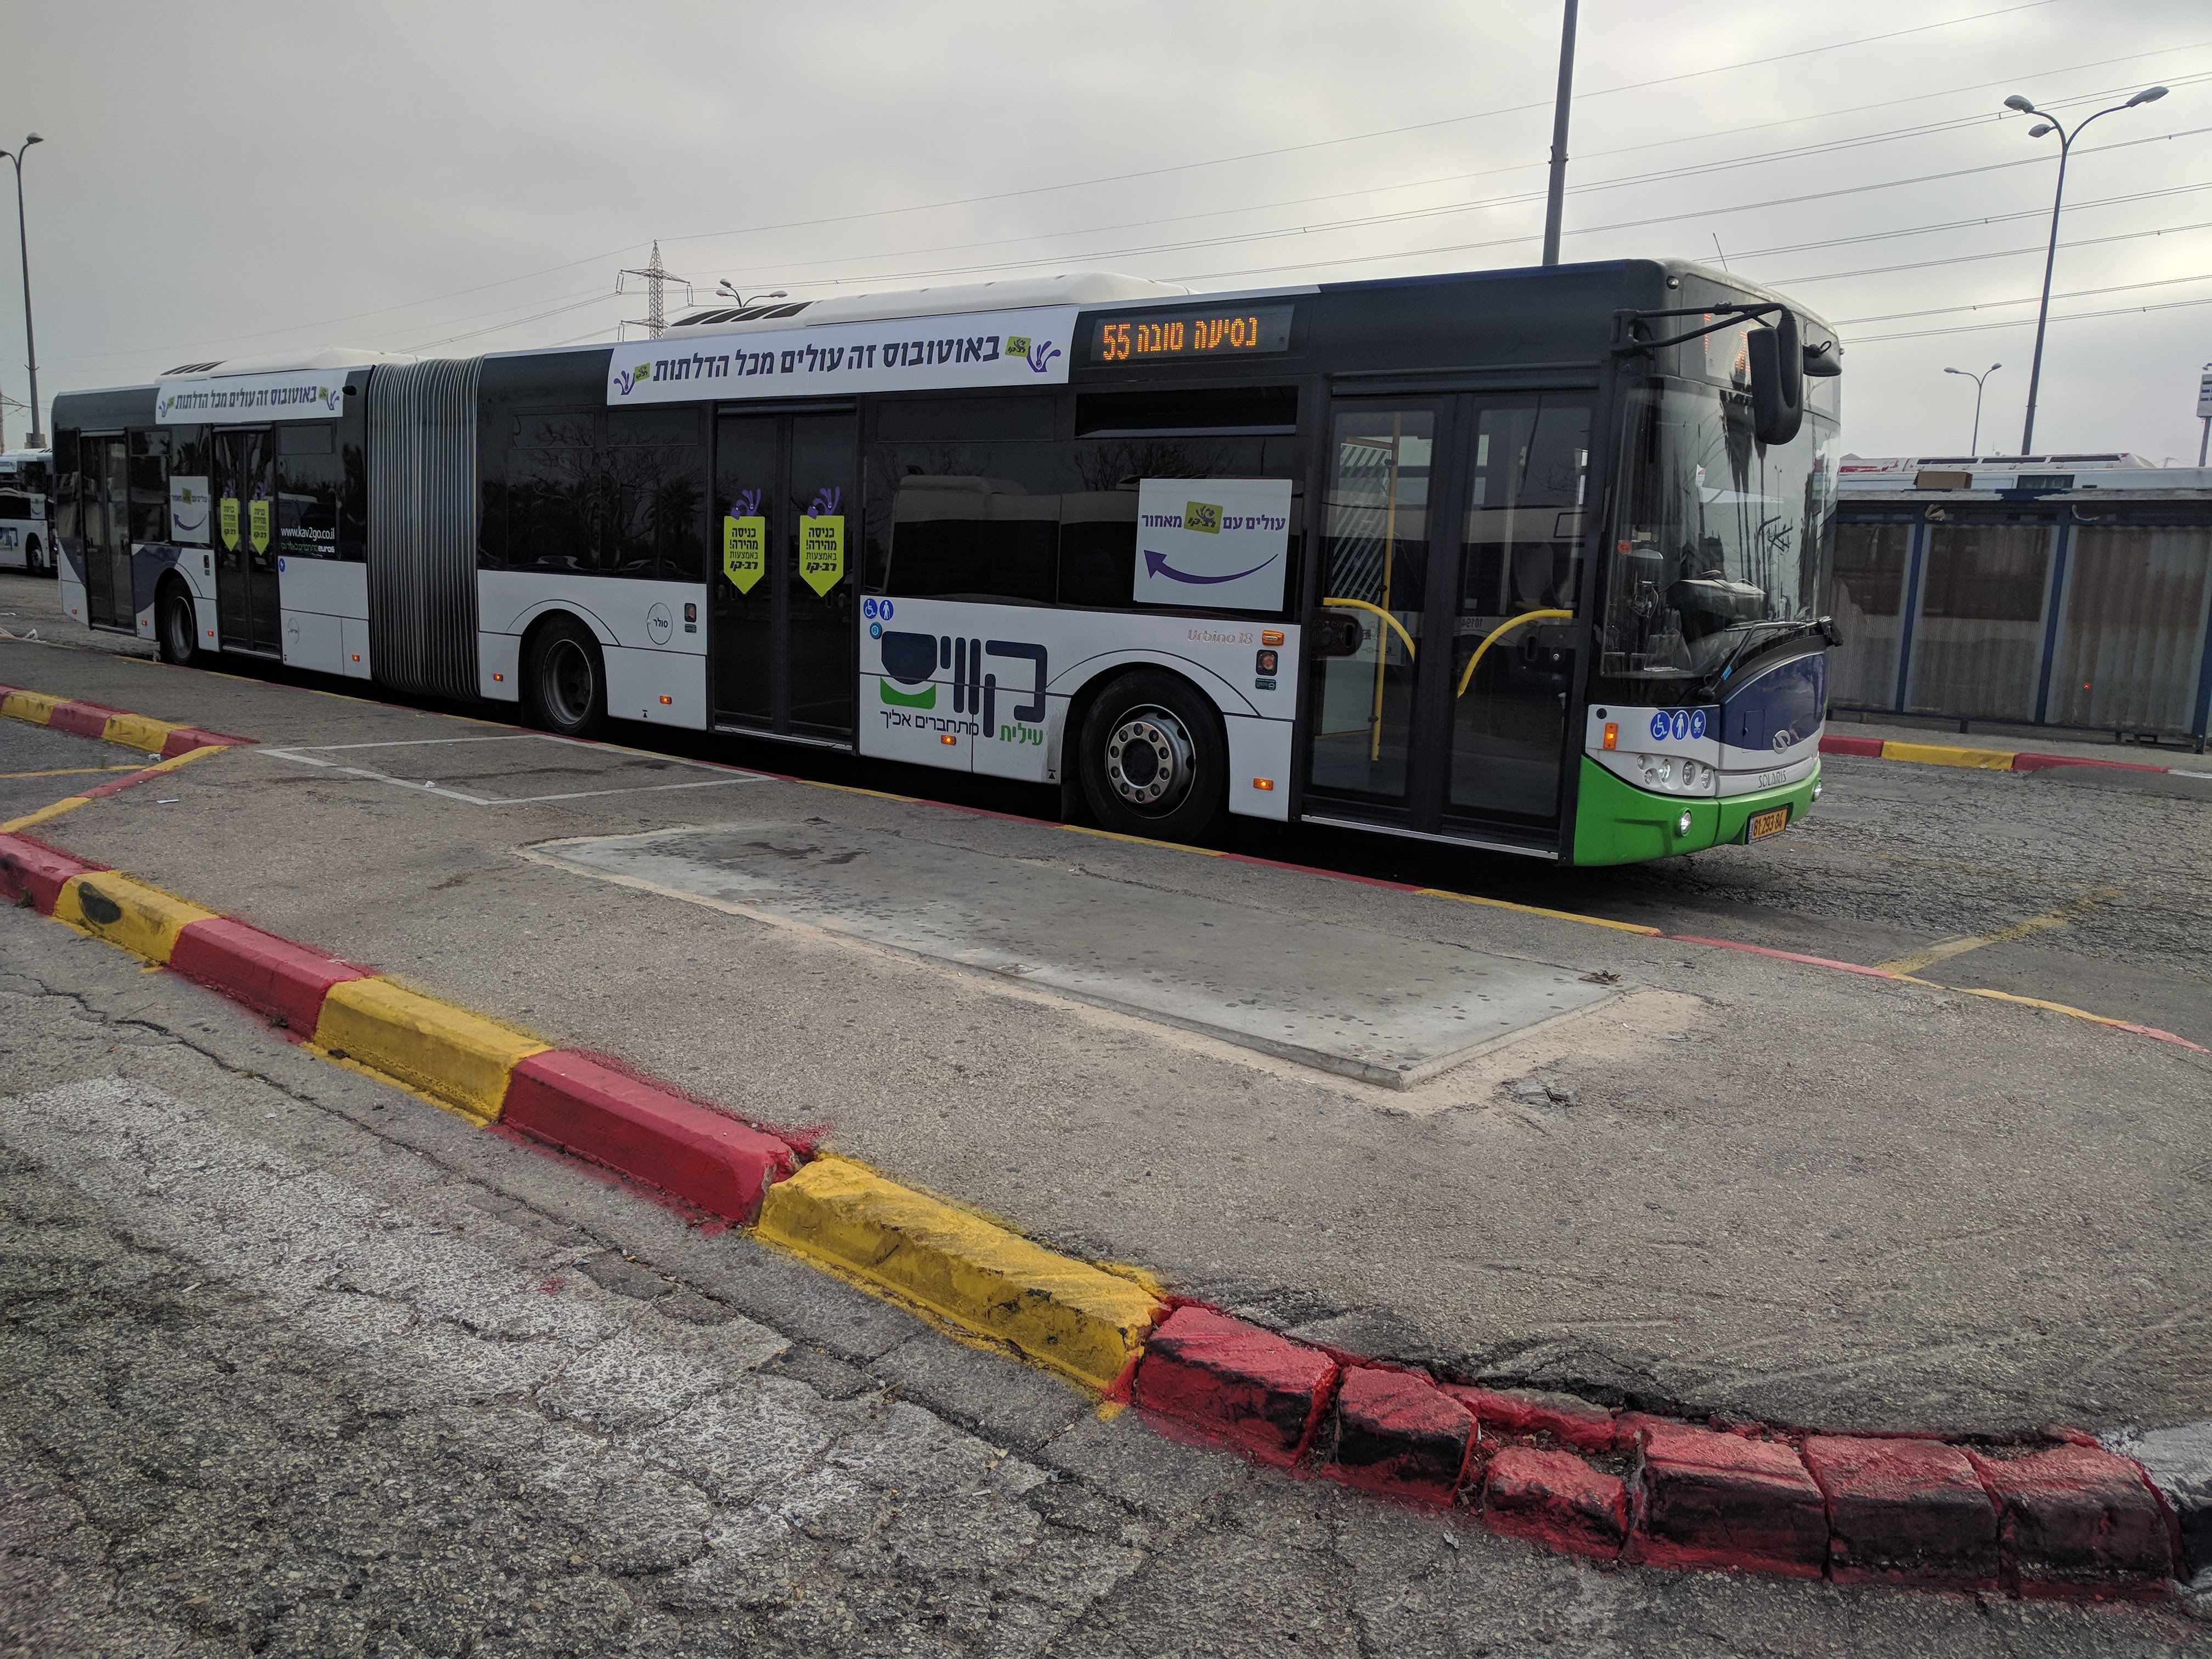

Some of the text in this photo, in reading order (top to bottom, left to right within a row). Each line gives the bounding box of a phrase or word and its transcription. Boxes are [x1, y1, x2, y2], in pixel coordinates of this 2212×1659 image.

[1103, 317, 1258, 360] נסיעה טובה 55
[653, 335, 1000, 382] באוטובוס זה עולים מכל הדלתות
[175, 386, 317, 409] באוטובוס זה עולים מכל הדלתות
[1141, 515, 1182, 528] מאחור
[1223, 517, 1243, 529] עם
[1245, 514, 1286, 531] עולים
[280, 526, 335, 541] www.kav2go.co.il
[732, 527, 757, 538] כניסה
[808, 527, 835, 538] כניסה
[730, 539, 759, 550] מהירה!
[806, 539, 837, 551] מהירה!
[730, 551, 759, 560] באמצעות
[806, 552, 837, 561] באמצעות
[653, 617, 668, 628] סולר
[1187, 629, 1254, 645] Urbino 18
[880, 709, 979, 736] מתחברים אליך
[1000, 722, 1043, 746] עילית
[1758, 770, 1786, 788] SOLARIS
